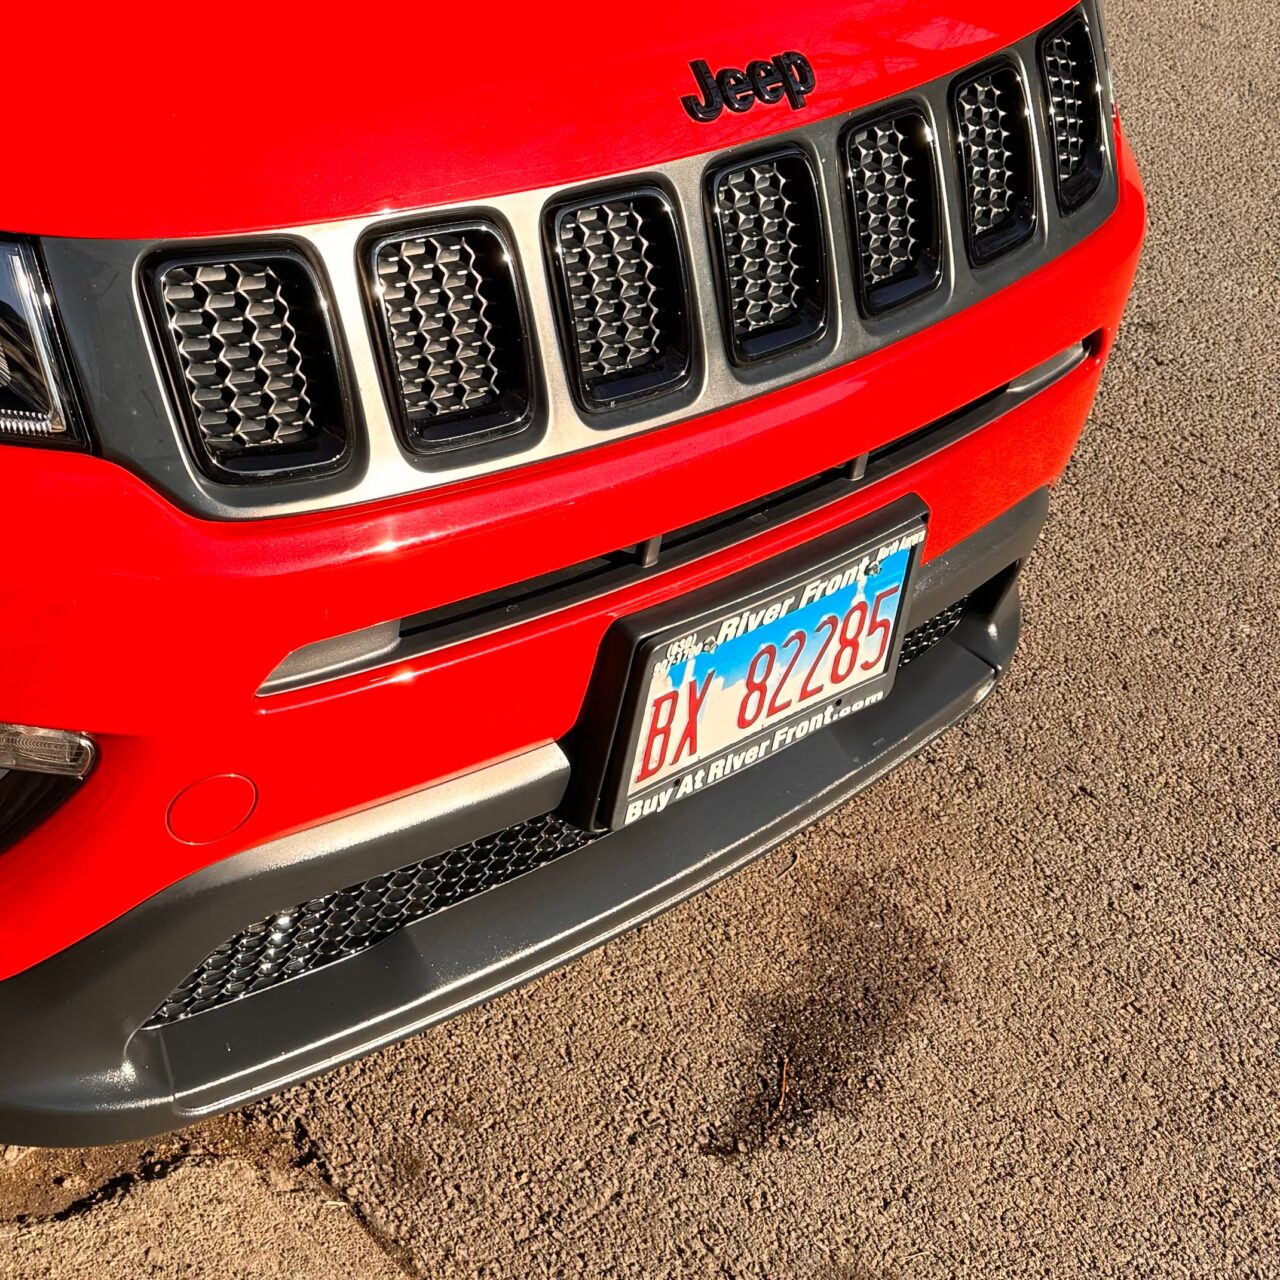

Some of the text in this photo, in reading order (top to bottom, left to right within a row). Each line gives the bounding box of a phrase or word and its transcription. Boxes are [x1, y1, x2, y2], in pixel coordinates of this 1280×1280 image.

[680, 51, 816, 123] Jeep
[716, 556, 870, 646] River Front
[635, 585, 900, 783] BX 82285
[624, 690, 885, 826] Buy At River Front.com
